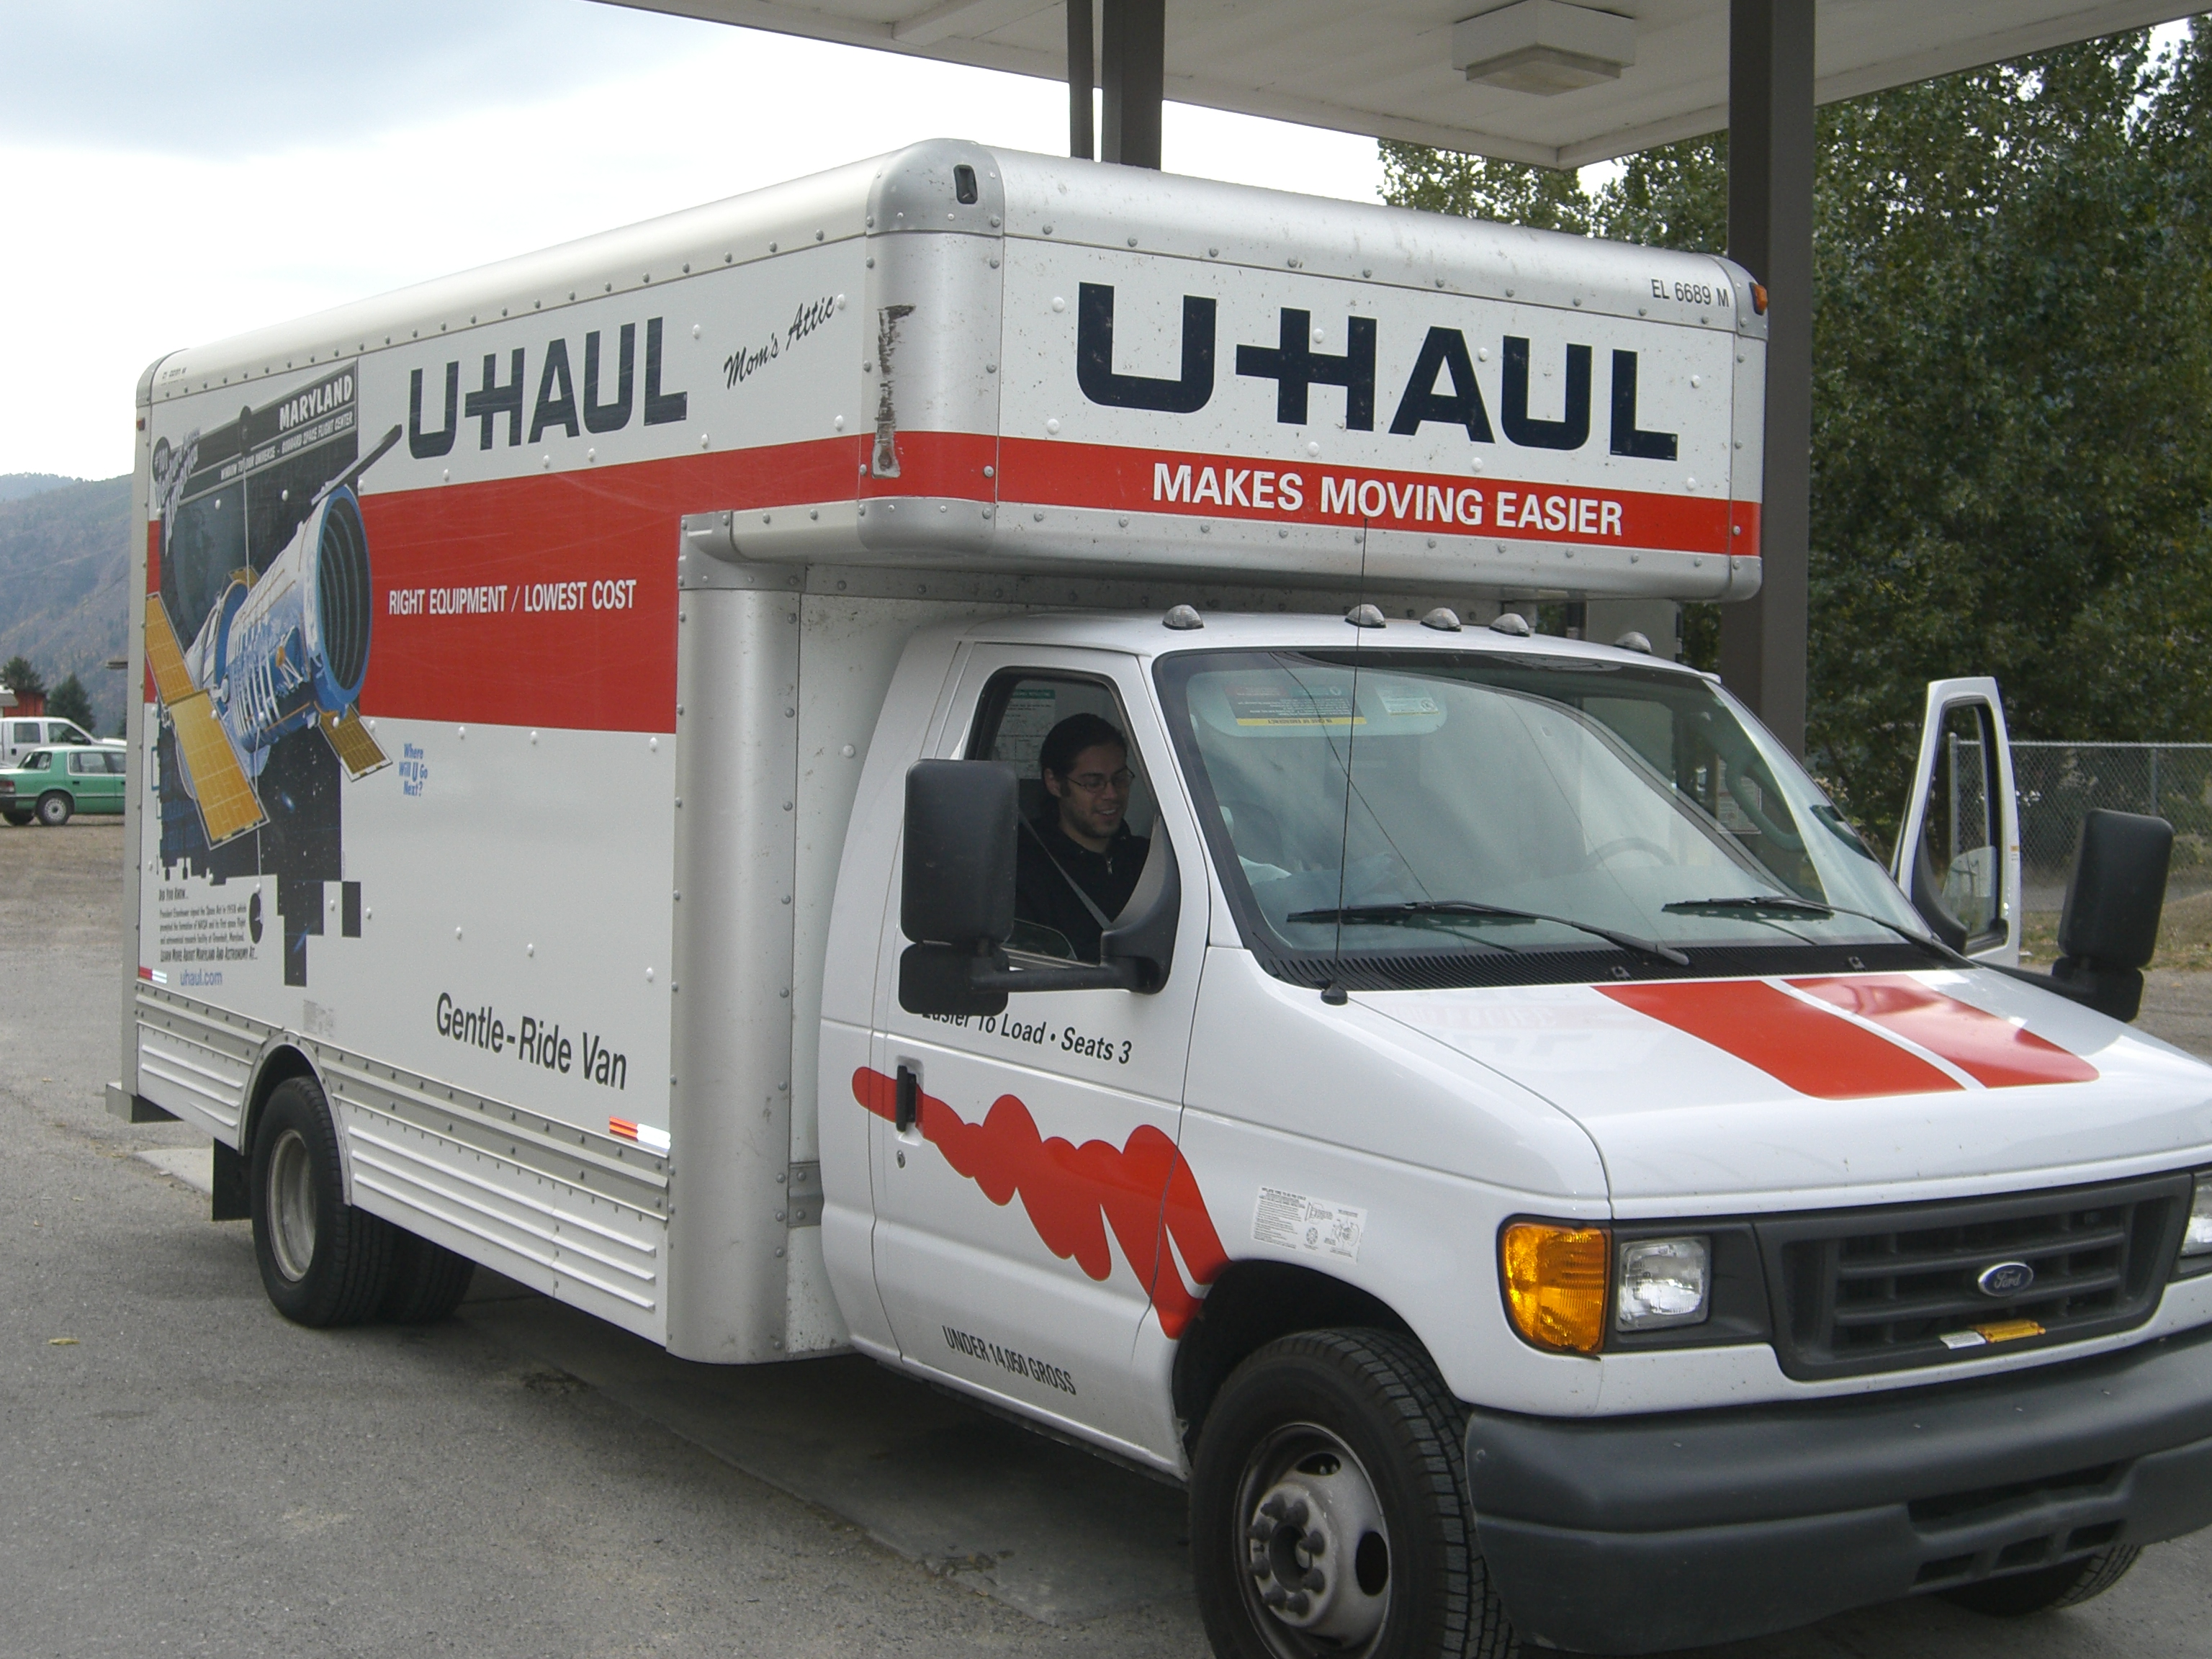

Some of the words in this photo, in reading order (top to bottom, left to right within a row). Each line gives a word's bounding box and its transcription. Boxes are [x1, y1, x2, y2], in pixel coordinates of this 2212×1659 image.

[1651, 279, 1670, 300] EL
[1675, 282, 1712, 305] 6689
[1717, 287, 1730, 307] M
[724, 332, 779, 390] Mom's
[786, 296, 834, 351] Attic
[409, 317, 688, 459] U-HAUL
[1077, 282, 1678, 461] U-HAUL
[279, 375, 353, 431] MARYLAND
[334, 411, 353, 431] CENTER
[1154, 462, 1303, 511] MAKES
[1320, 476, 1483, 526] MOVING
[1496, 491, 1622, 536] EASIER
[389, 589, 425, 615] RIGHT
[429, 585, 508, 614] EQUIPMENT
[524, 582, 587, 612] LOWEST
[592, 580, 637, 609] COST
[181, 969, 222, 986] uhaul.com
[436, 992, 572, 1074] Gentle-Ride
[582, 1032, 626, 1090] Van
[1000, 1013, 1046, 1044] Load
[1061, 1027, 1114, 1061] Seats
[1118, 1040, 1132, 1064] 3
[1994, 1270, 2022, 1289] Ford
[941, 1325, 990, 1362] UNDER
[1028, 1357, 1076, 1395] GROSS
